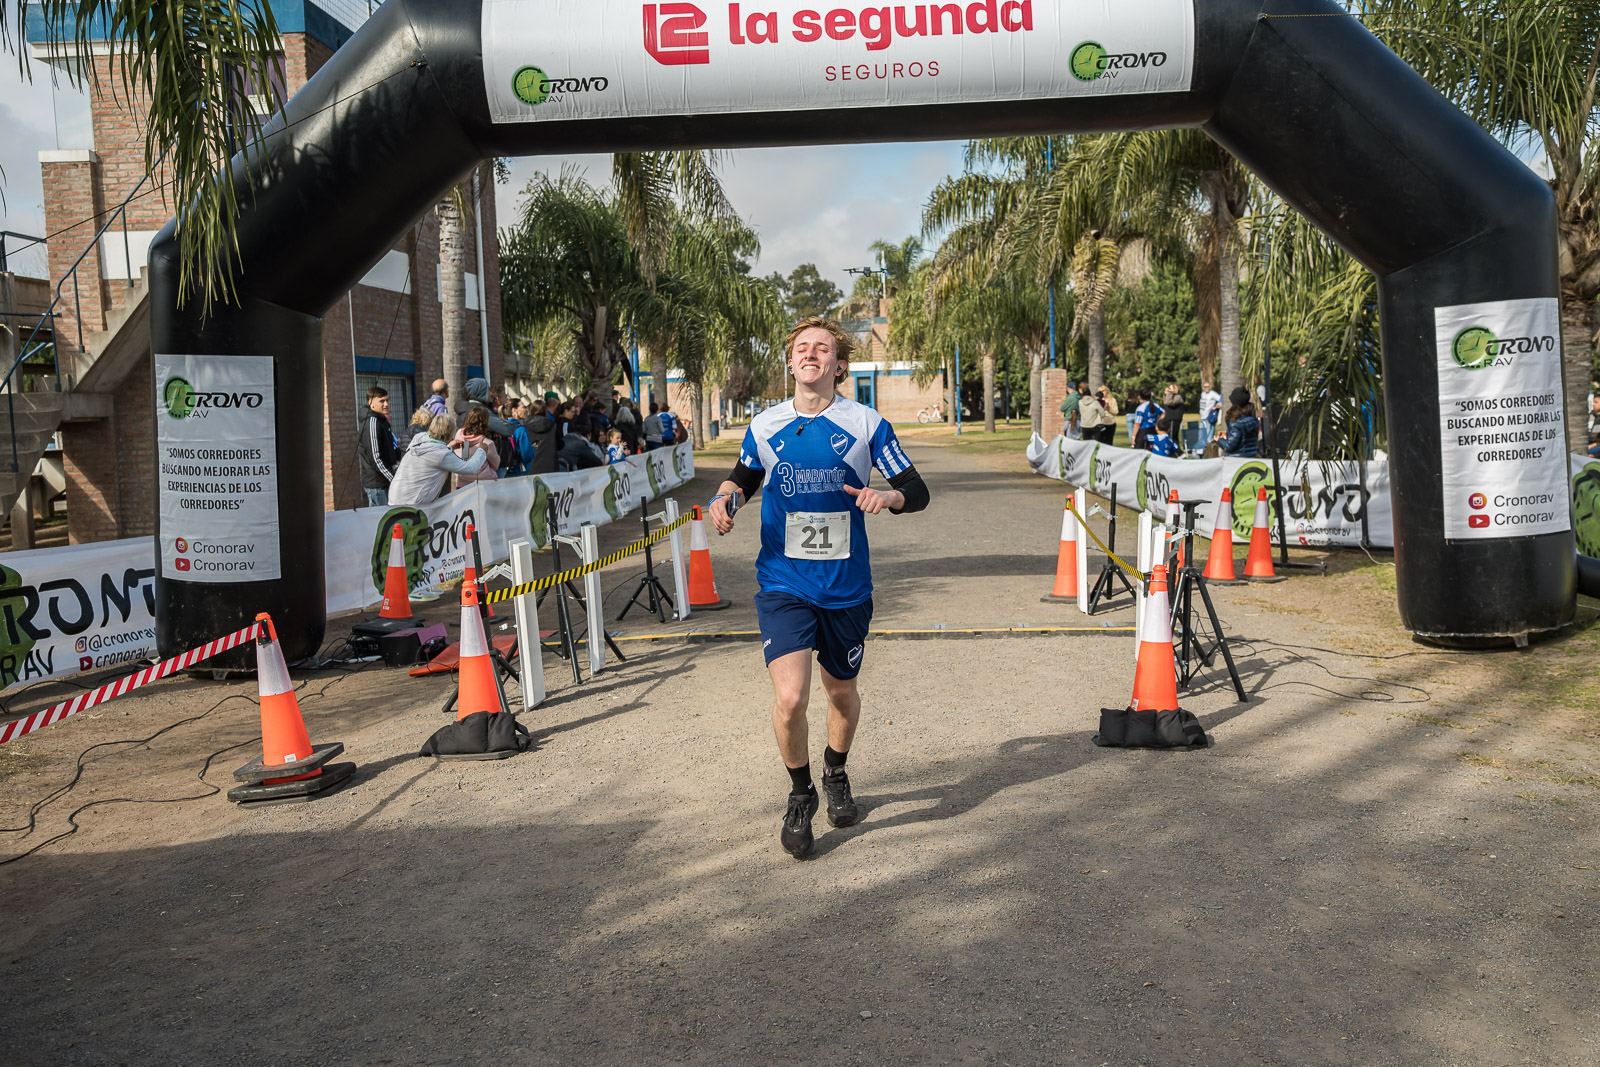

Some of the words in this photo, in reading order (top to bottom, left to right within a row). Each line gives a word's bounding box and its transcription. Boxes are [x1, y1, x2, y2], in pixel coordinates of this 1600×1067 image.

[729, 3, 778, 44] la
[792, 0, 1033, 51] segunda
[1096, 52, 1167, 69] CRONO
[825, 61, 940, 81] SEGUROS
[1094, 71, 1119, 79] RAV
[539, 77, 608, 94] CRONO
[539, 95, 563, 103] RAV
[1485, 336, 1554, 356] CRONO
[1484, 357, 1513, 367] RAV
[185, 392, 263, 408] CRONO
[1455, 398, 1498, 412] “SOMOS
[1500, 394, 1555, 409] CORREDORES
[184, 409, 209, 419] RAV
[1447, 415, 1504, 430] BUSCANDO
[1507, 412, 1549, 426] MEJORAR
[1550, 410, 1560, 422] LAS
[1458, 431, 1530, 446] EXPERIENCIAS
[1532, 430, 1543, 441] DE
[1545, 428, 1556, 440] LOS
[197, 449, 261, 460] CORREDORES
[1477, 447, 1546, 462] CORREDORES”
[162, 464, 201, 476] BUSCANDO
[204, 465, 250, 477] MEJORAR
[253, 465, 270, 476] LAS
[795, 467, 846, 484] MARATÓN
[168, 481, 226, 493] EXPERIENCIAS
[228, 483, 242, 493] DE
[244, 482, 262, 493] LOS
[777, 462, 796, 497] 3
[180, 499, 245, 510] CORREDORES”
[1494, 493, 1554, 507] Cronorav
[1494, 511, 1554, 526] Cronorav
[801, 526, 832, 548] 21
[193, 541, 255, 553] Cronorav
[193, 559, 255, 571] Cronorav
[1, 645, 55, 685] RAV
[95, 646, 150, 668] cronorav
